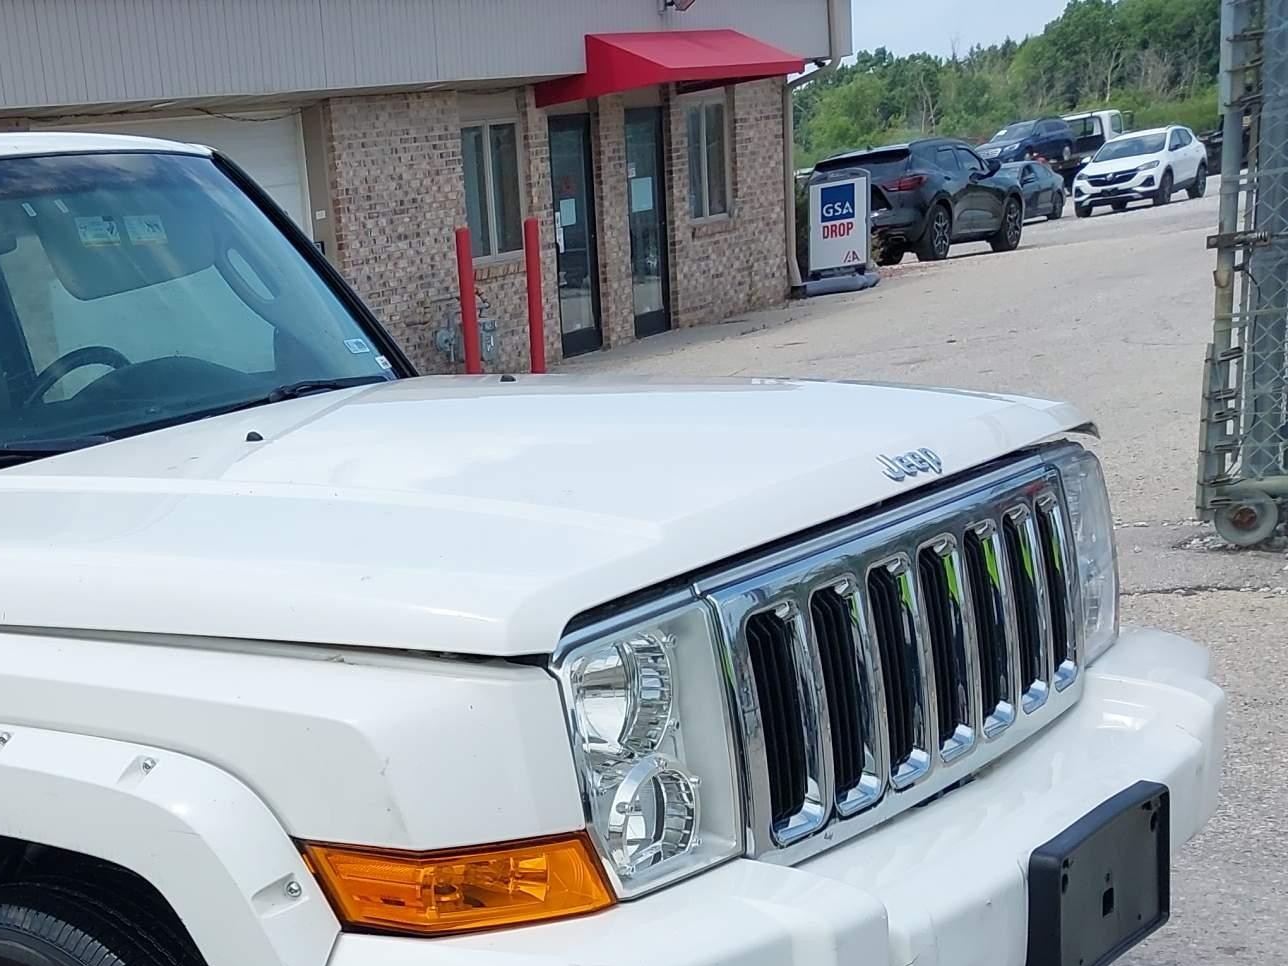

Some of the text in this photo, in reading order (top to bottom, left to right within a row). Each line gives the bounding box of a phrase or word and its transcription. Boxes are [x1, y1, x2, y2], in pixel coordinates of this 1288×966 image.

[822, 200, 854, 218] GSA
[822, 221, 854, 240] DROP
[875, 447, 943, 482] Jeep
